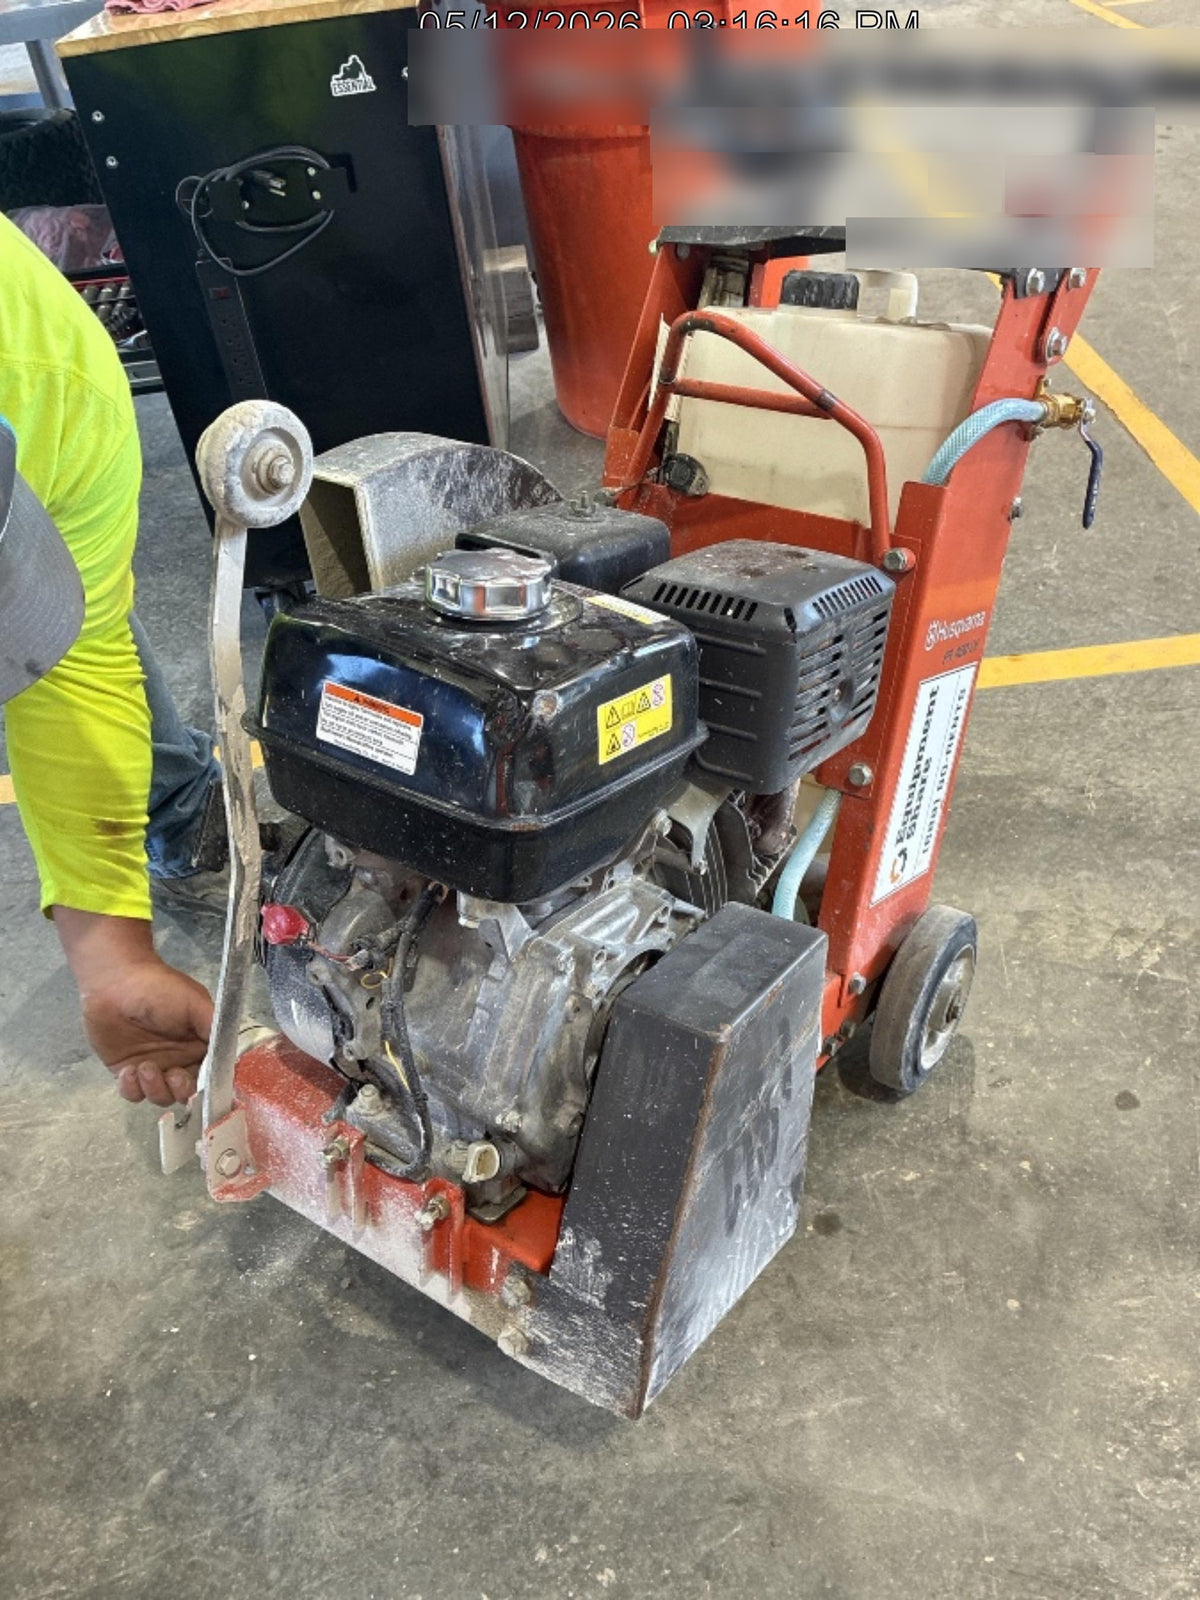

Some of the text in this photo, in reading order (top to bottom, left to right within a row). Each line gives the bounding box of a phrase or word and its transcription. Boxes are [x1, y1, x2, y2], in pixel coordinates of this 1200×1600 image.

[332, 78, 374, 95] ESSENTIAL
[895, 685, 939, 846] Equipment
[906, 757, 932, 840] Share
